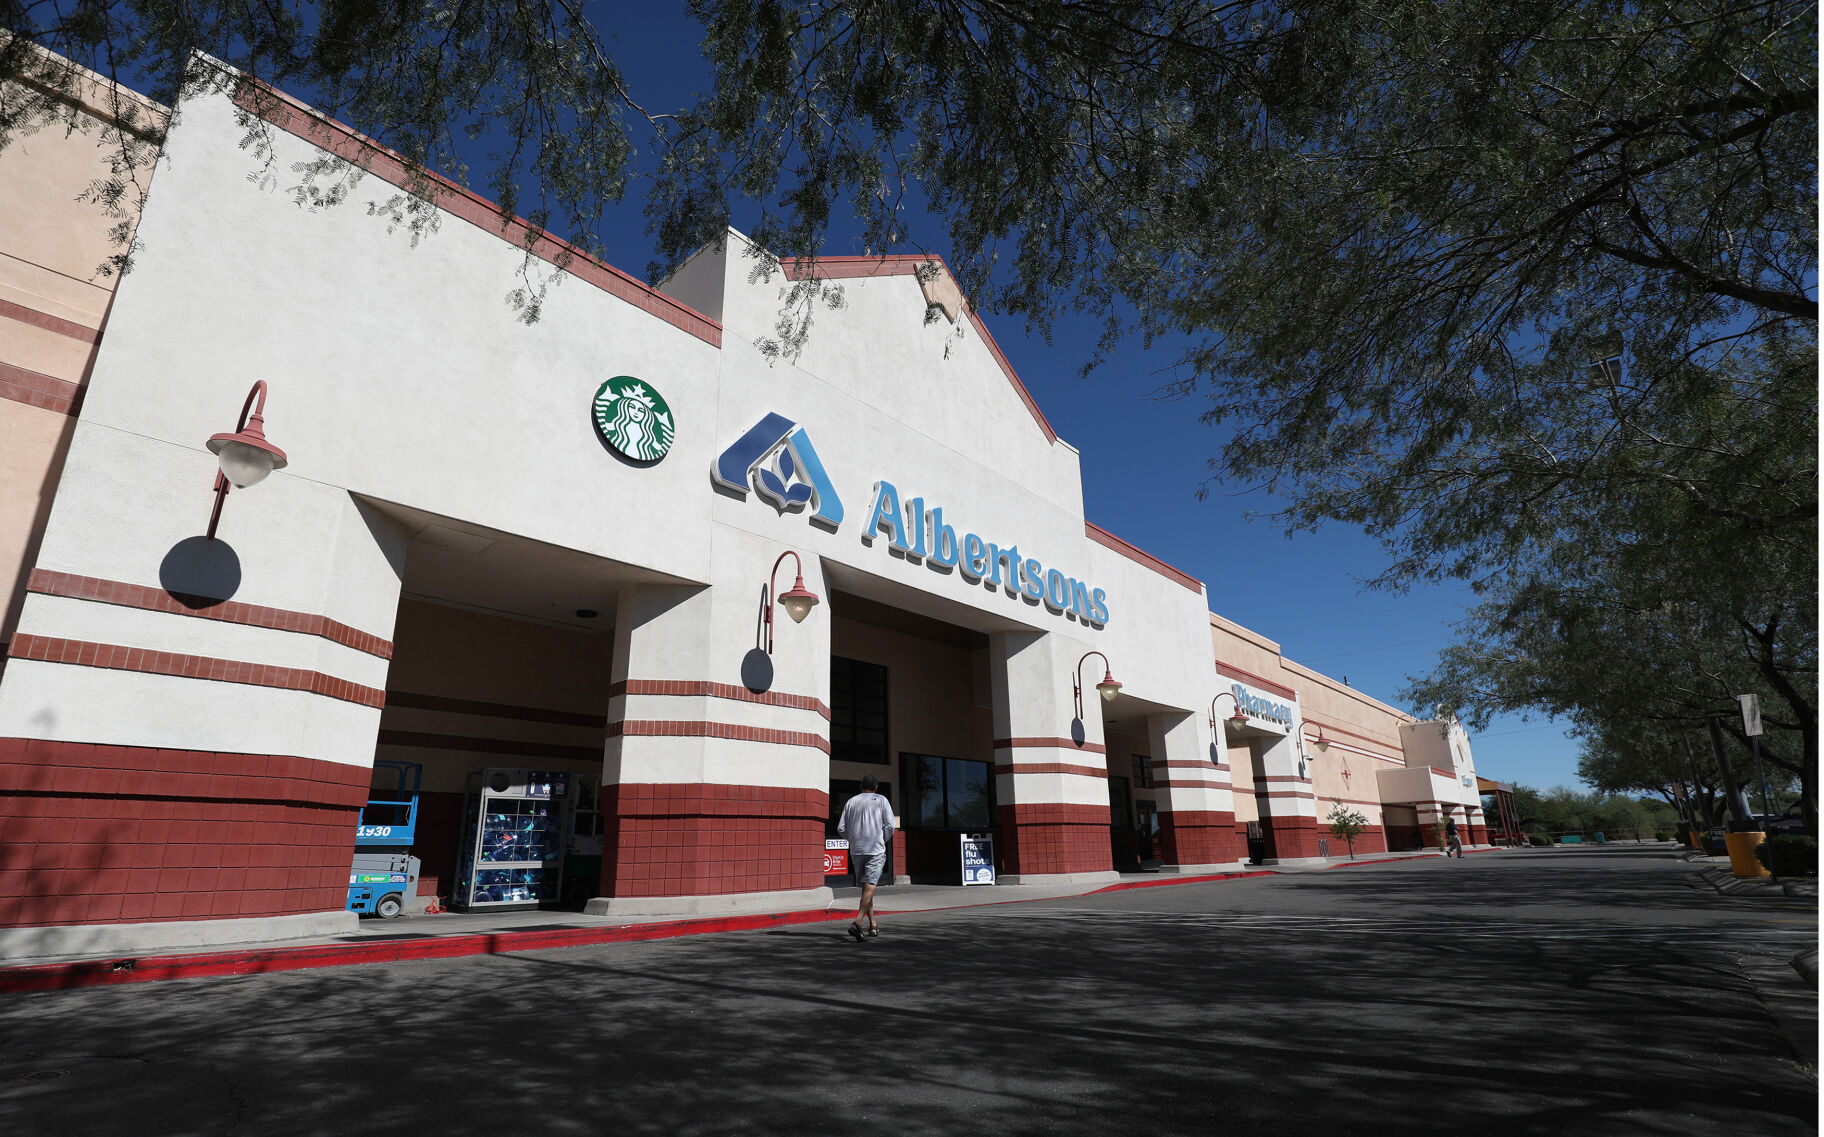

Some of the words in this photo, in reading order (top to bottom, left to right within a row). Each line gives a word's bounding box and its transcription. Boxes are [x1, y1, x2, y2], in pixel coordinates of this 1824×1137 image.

[862, 480, 1110, 625] Albertsons
[1233, 684, 1293, 729] Pharmacy
[356, 825, 392, 837] 1930
[826, 840, 848, 848] ENTER
[965, 843, 984, 851] FREE
[965, 850, 977, 858] flu
